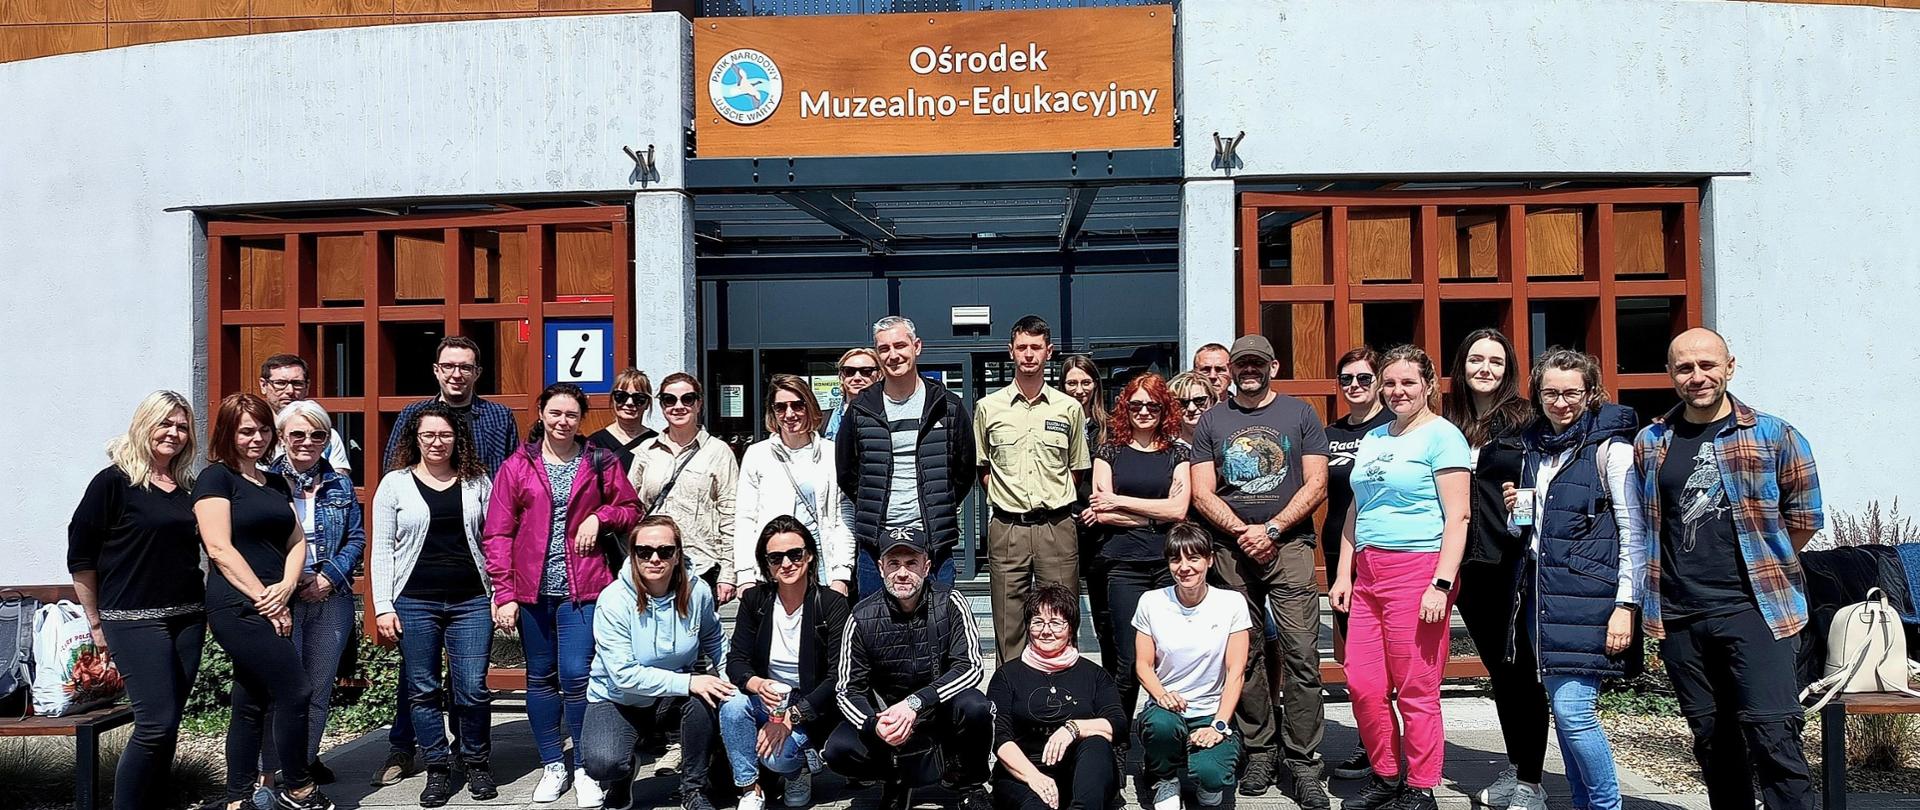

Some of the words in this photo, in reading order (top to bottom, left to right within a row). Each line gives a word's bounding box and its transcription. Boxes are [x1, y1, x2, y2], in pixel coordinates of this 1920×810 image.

[711, 58, 729, 82] PARK
[730, 51, 779, 80] NARODOWY
[909, 42, 1048, 74] Ośrodek
[799, 82, 1158, 118] Muzealno-Edukacyjny
